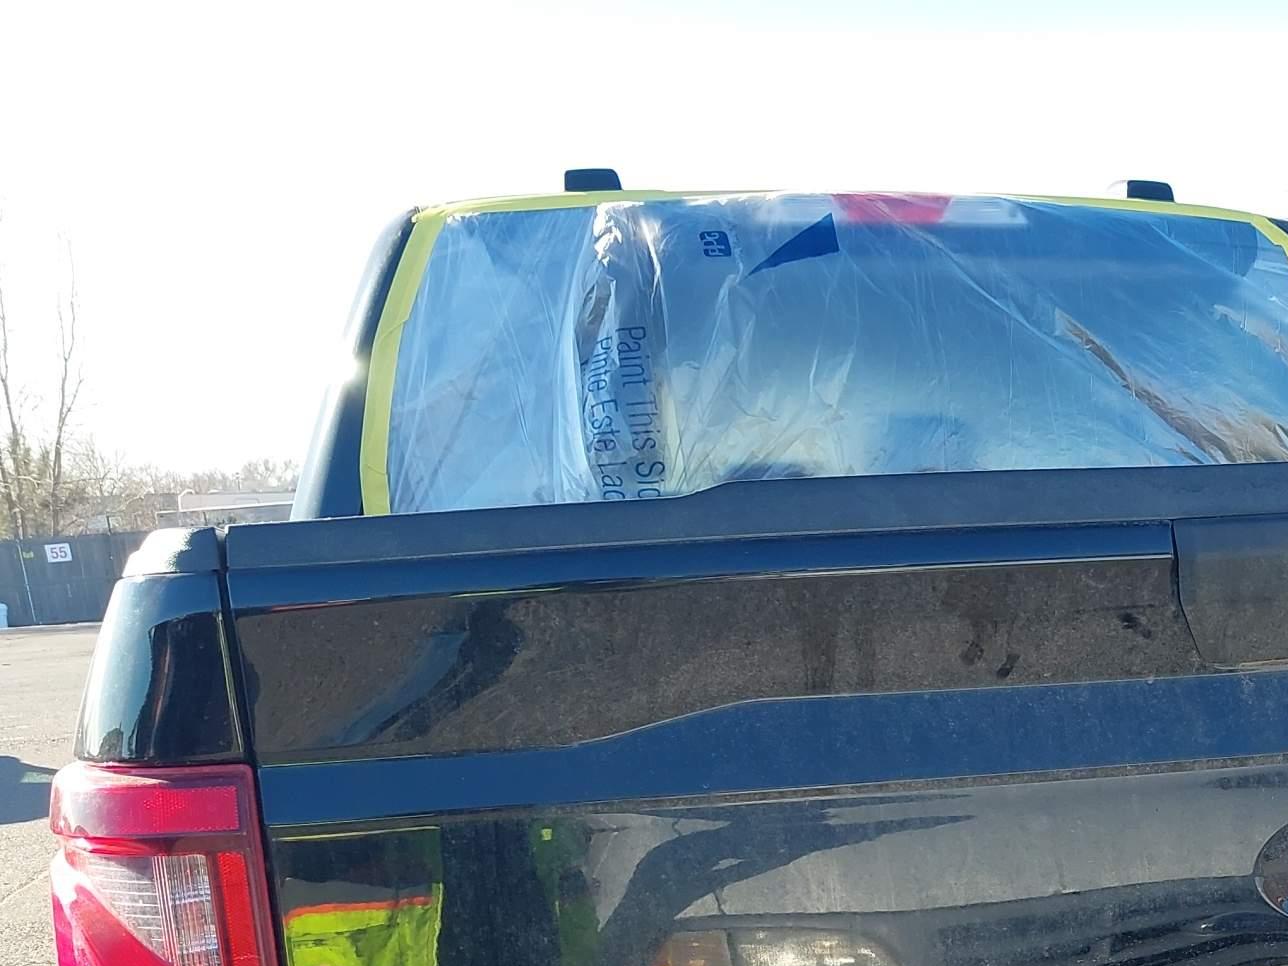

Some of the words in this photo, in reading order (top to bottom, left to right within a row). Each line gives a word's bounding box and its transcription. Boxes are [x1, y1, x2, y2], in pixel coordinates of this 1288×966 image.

[616, 326, 651, 388] Paint
[591, 399, 620, 452] Este
[626, 400, 660, 451] This
[50, 546, 68, 559] 55
